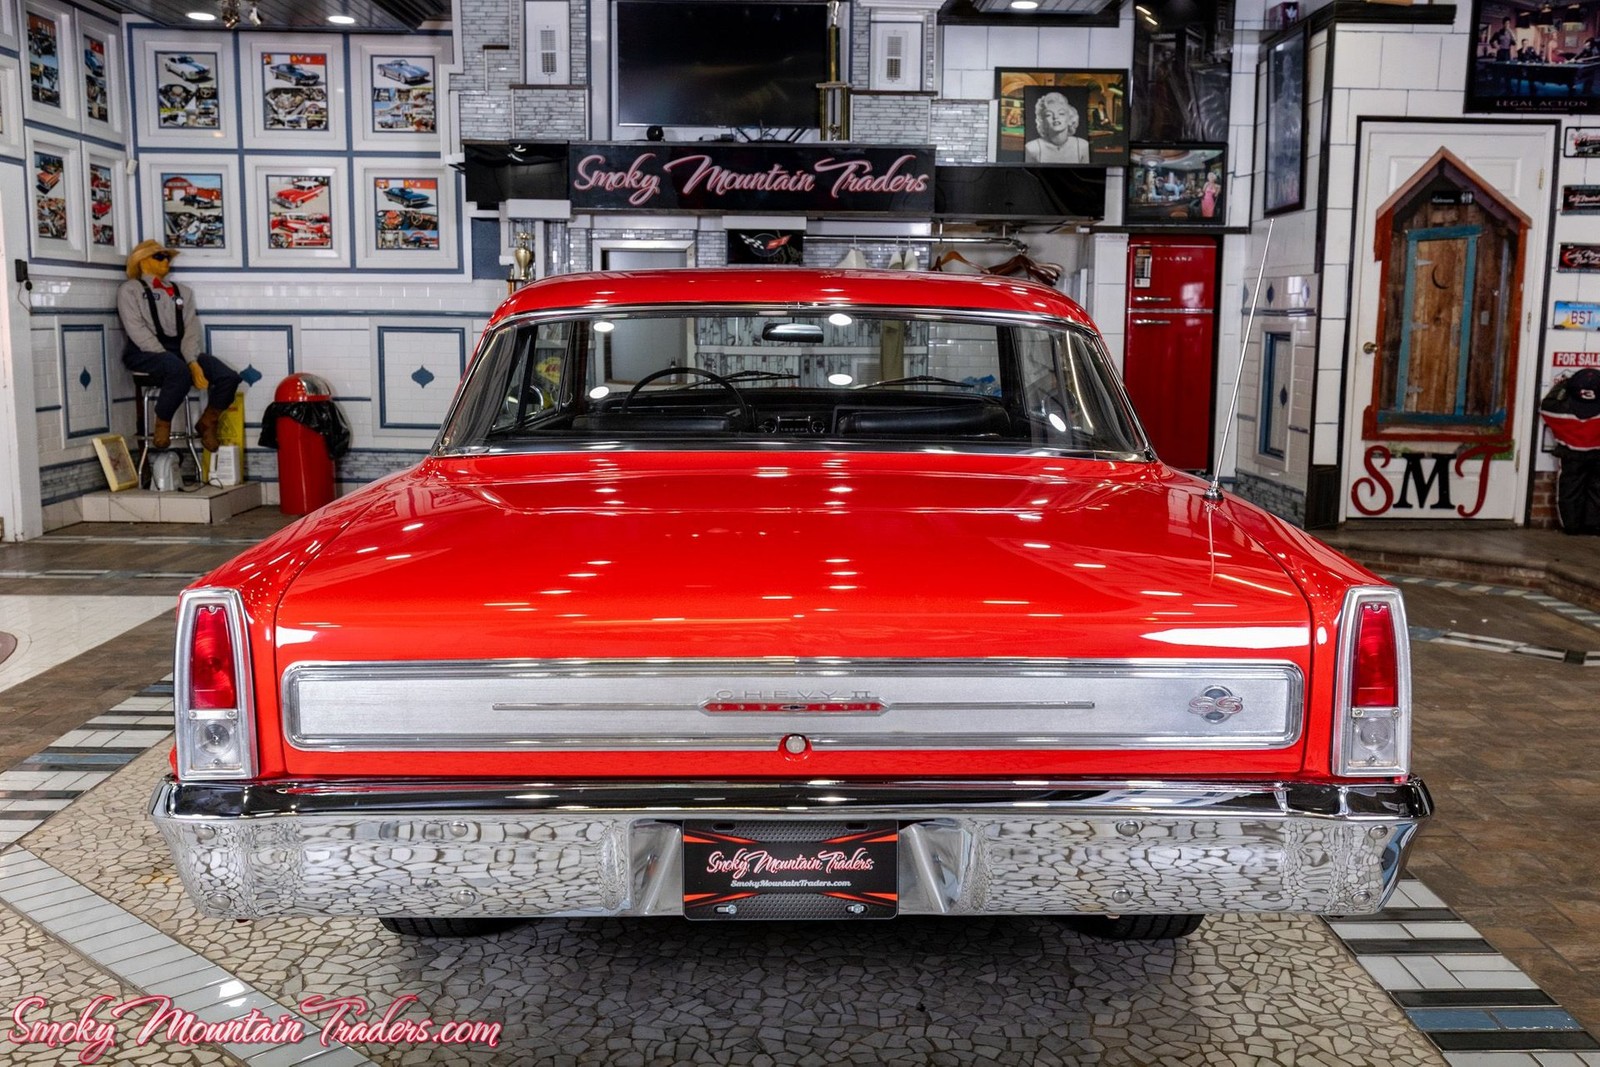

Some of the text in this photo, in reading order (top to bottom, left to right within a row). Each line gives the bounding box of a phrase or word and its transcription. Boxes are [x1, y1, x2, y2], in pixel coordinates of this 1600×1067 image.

[574, 153, 929, 205] Smoky Mountain Traders
[1557, 353, 1576, 365] FOR
[1580, 388, 1596, 400] 3
[716, 690, 838, 700] CHEVY
[706, 847, 875, 879] Smoky Mountain Traders
[730, 879, 852, 889] SmokyMountainTraders.com
